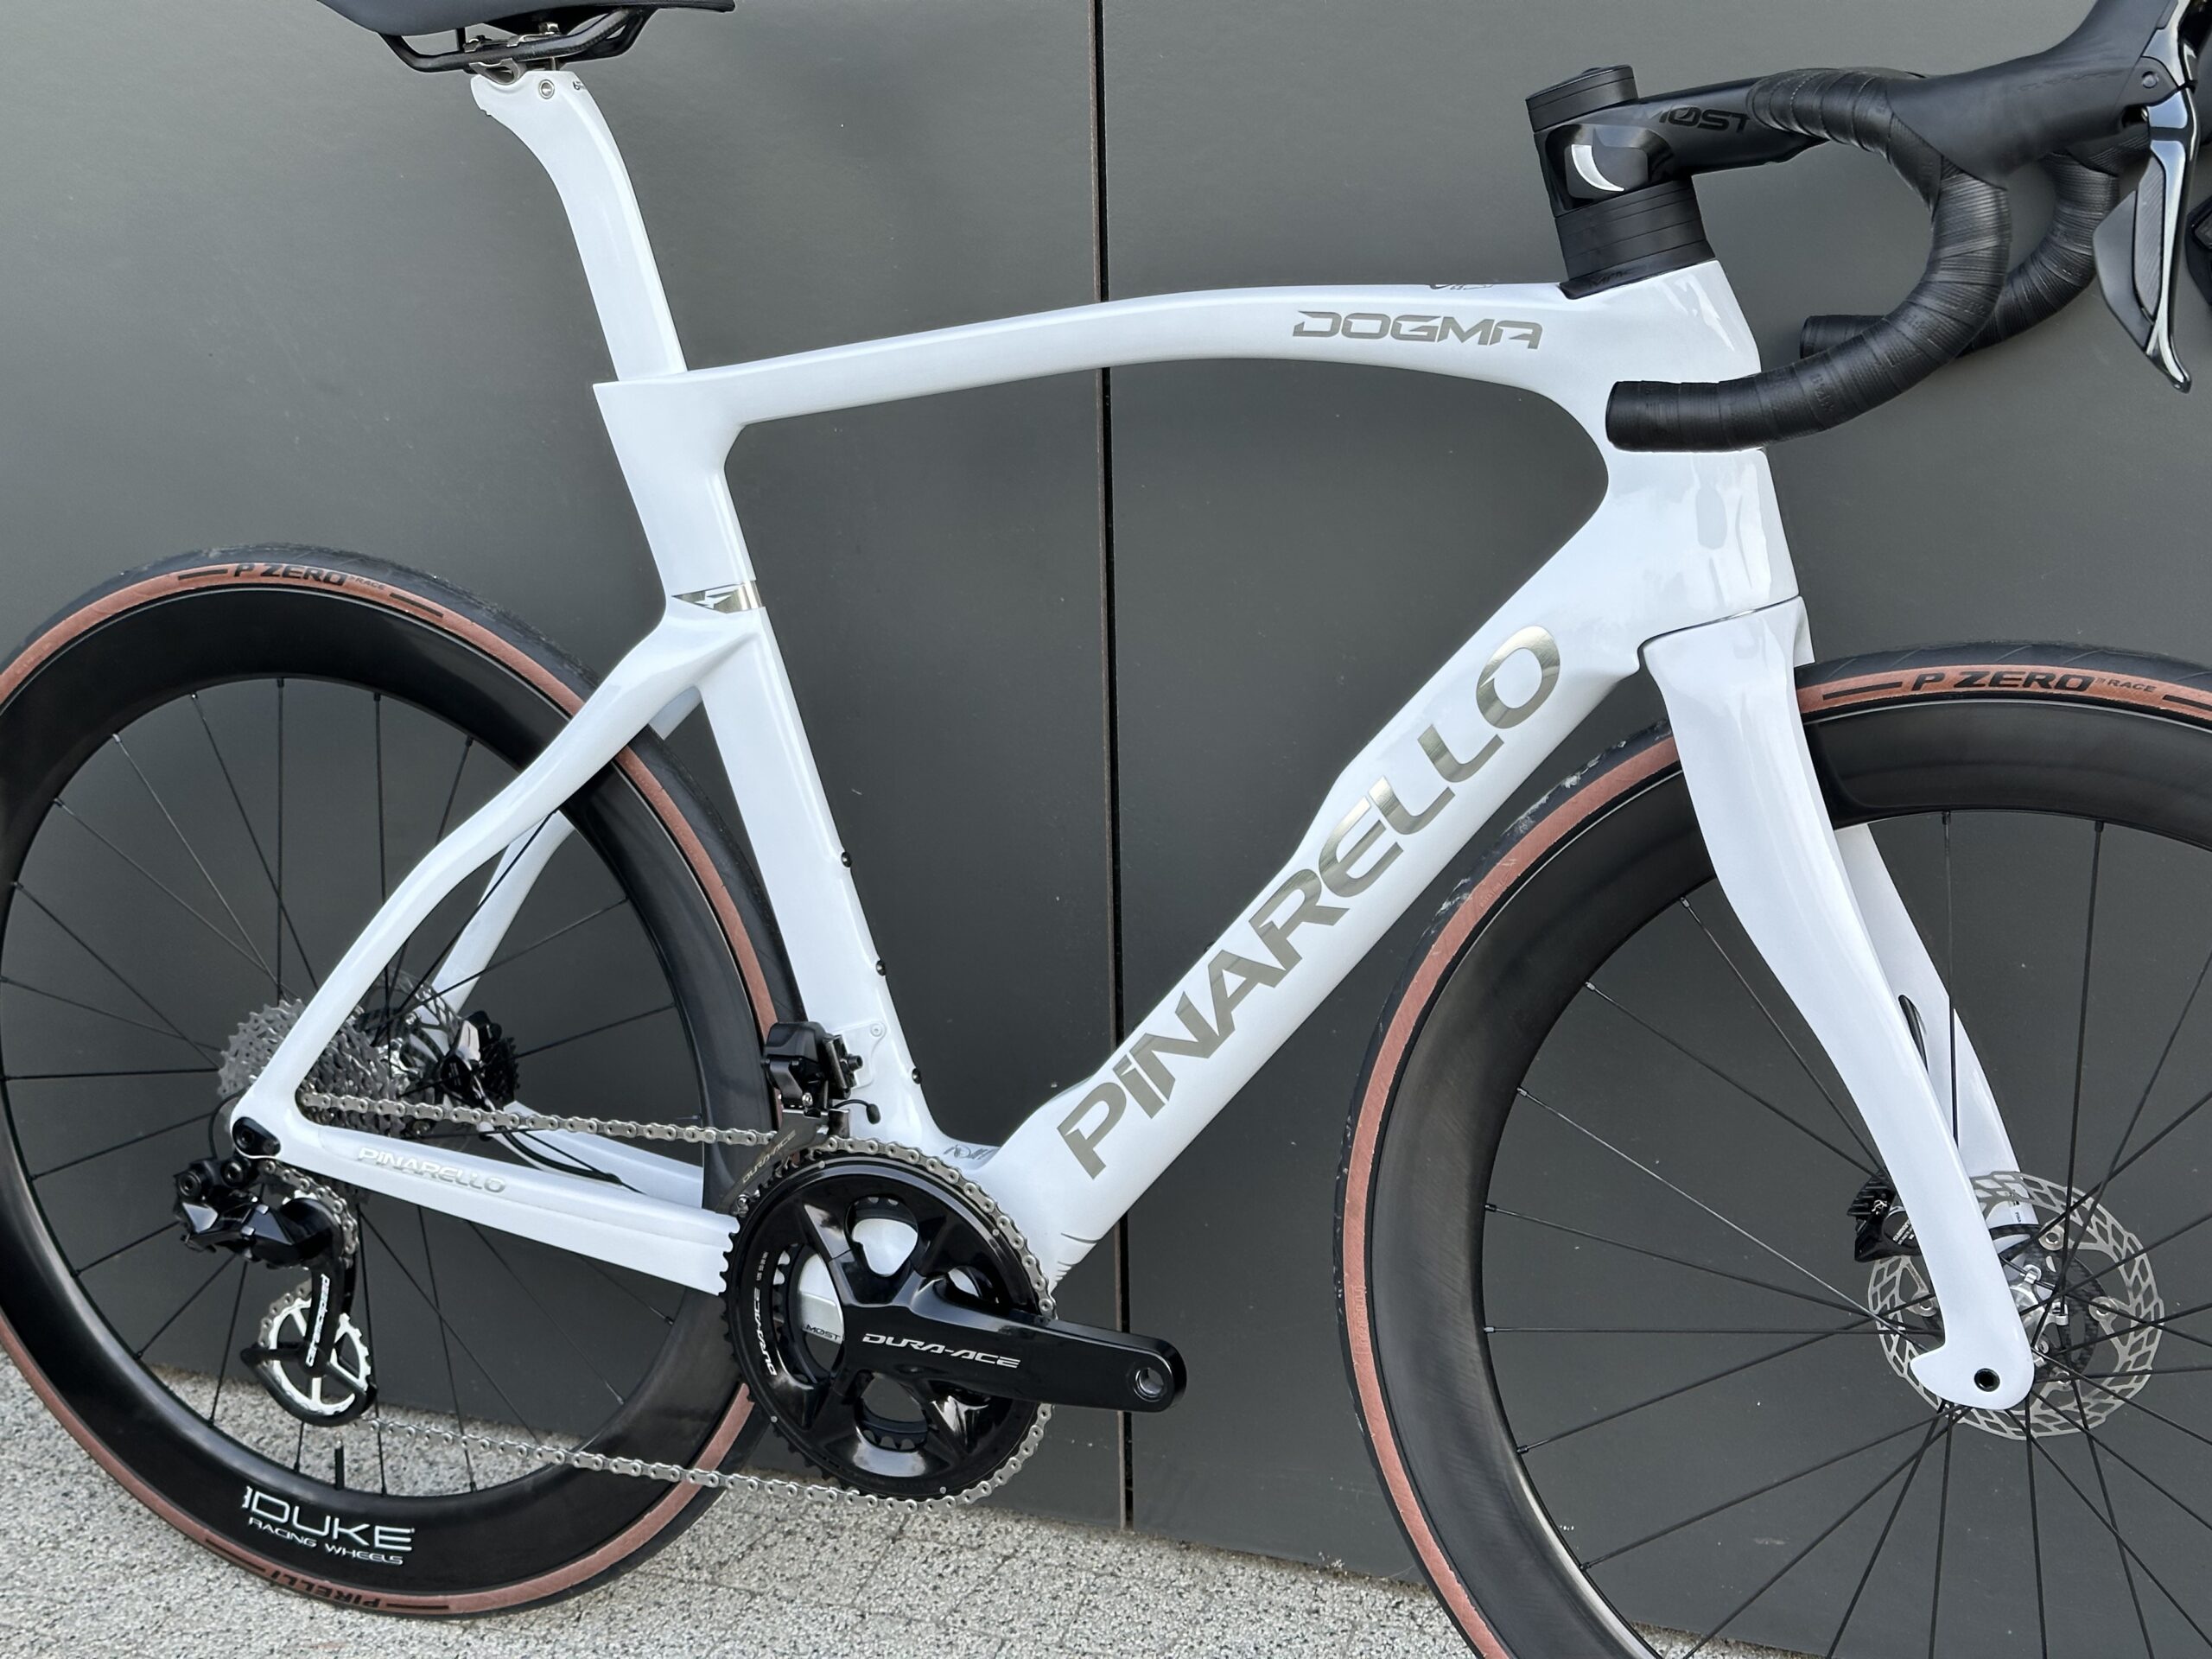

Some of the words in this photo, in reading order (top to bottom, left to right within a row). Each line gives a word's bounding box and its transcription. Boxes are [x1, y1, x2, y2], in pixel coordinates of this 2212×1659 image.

[1292, 310, 1543, 349] DOGMA
[233, 563, 255, 577] P
[260, 563, 347, 586] ZERO
[1910, 671, 1946, 691] P
[1953, 670, 2096, 691] ZERO
[2106, 679, 2158, 692] RACE
[753, 1287, 778, 1376] DURA-ACE
[805, 1324, 841, 1341] MOST
[862, 1333, 1021, 1369] DURA-ACE
[248, 1516, 317, 1548] RACING
[325, 1543, 404, 1566] WHEELS
[270, 1570, 381, 1608] PIRELLI
